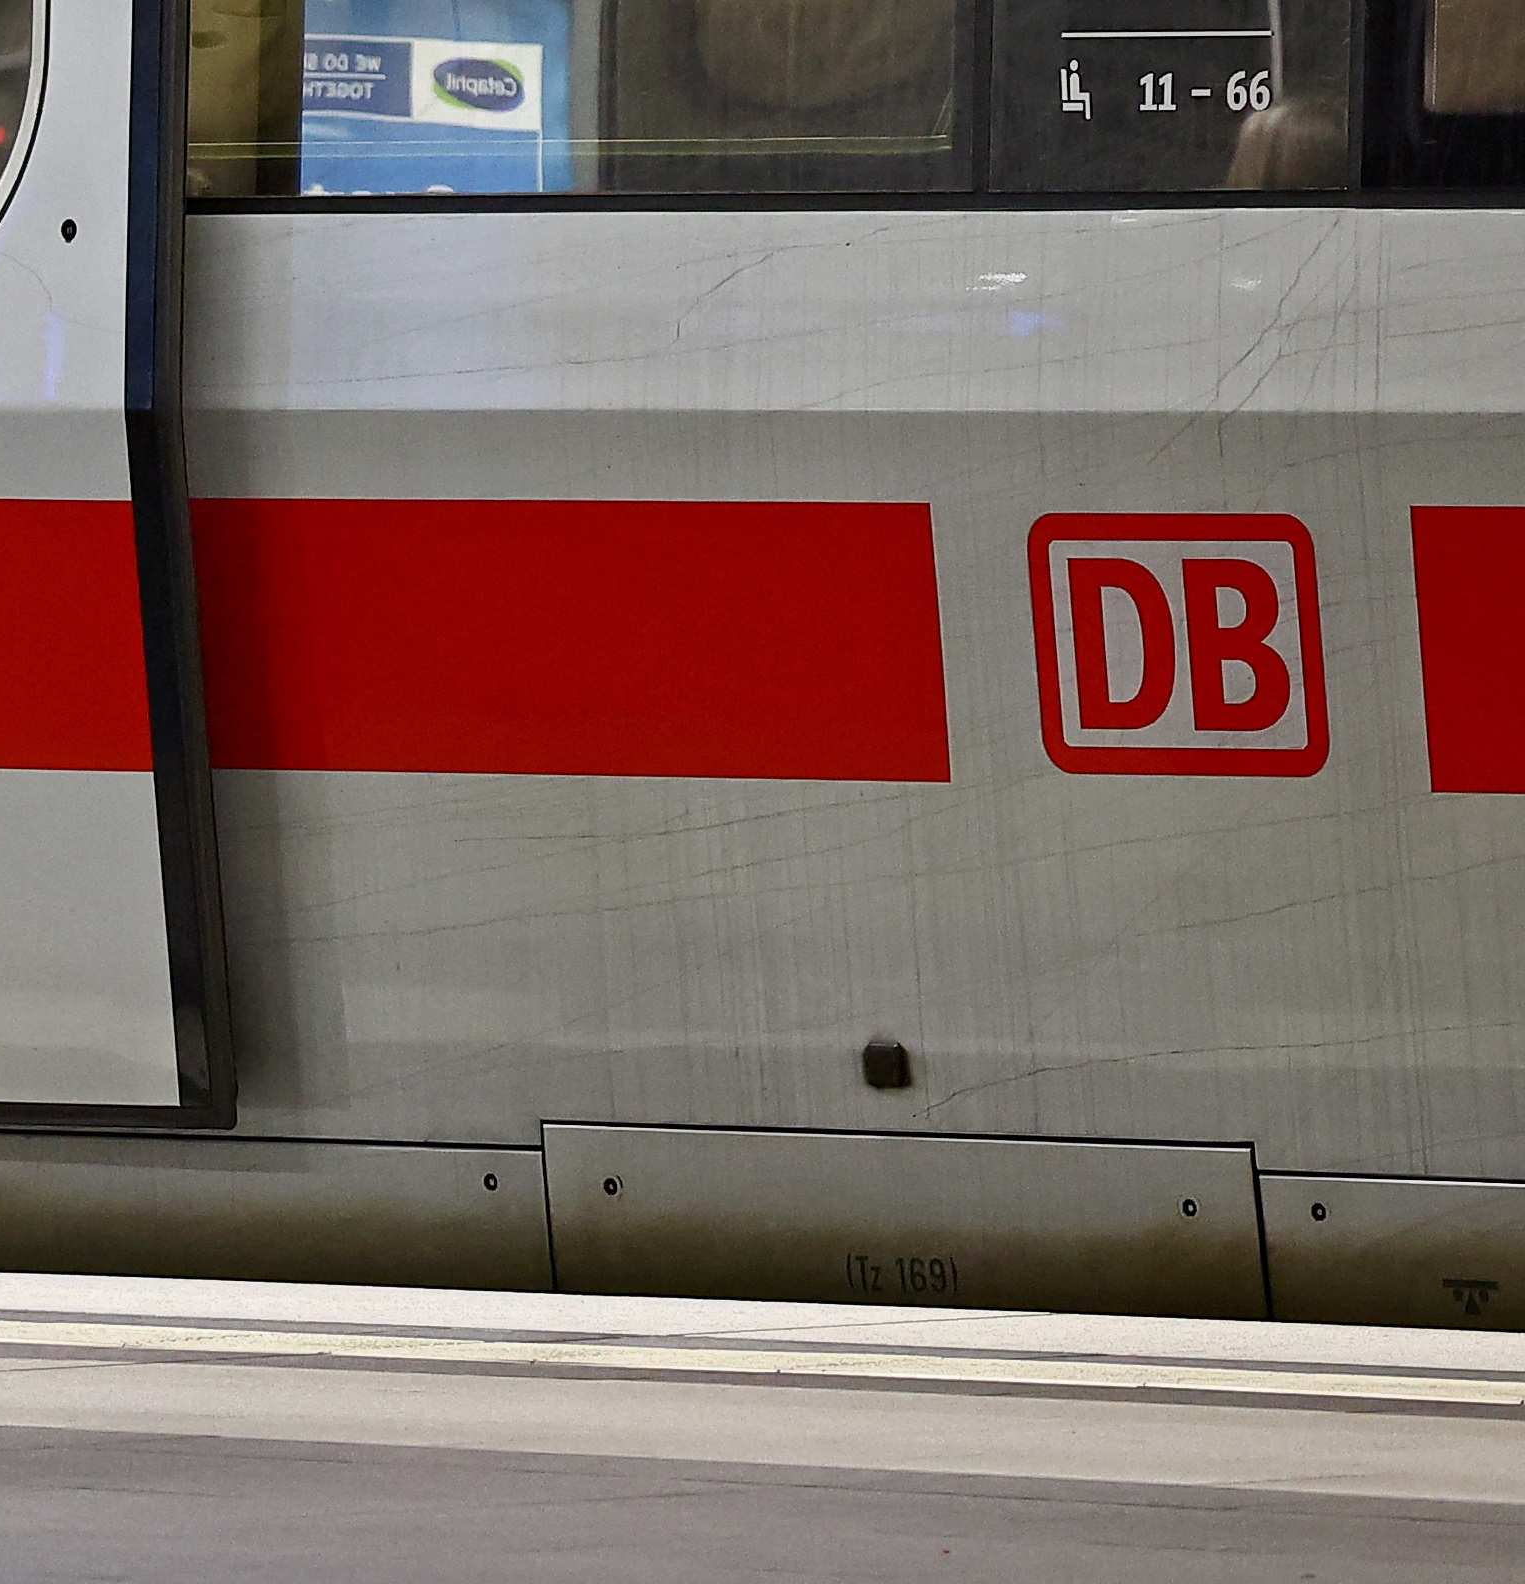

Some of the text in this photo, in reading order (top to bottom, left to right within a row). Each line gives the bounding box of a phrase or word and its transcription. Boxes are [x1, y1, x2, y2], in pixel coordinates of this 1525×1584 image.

[1139, 72, 1177, 112] 11
[1226, 70, 1271, 111] 66
[1066, 557, 1292, 733] DB
[895, 1256, 959, 1294] 169)
